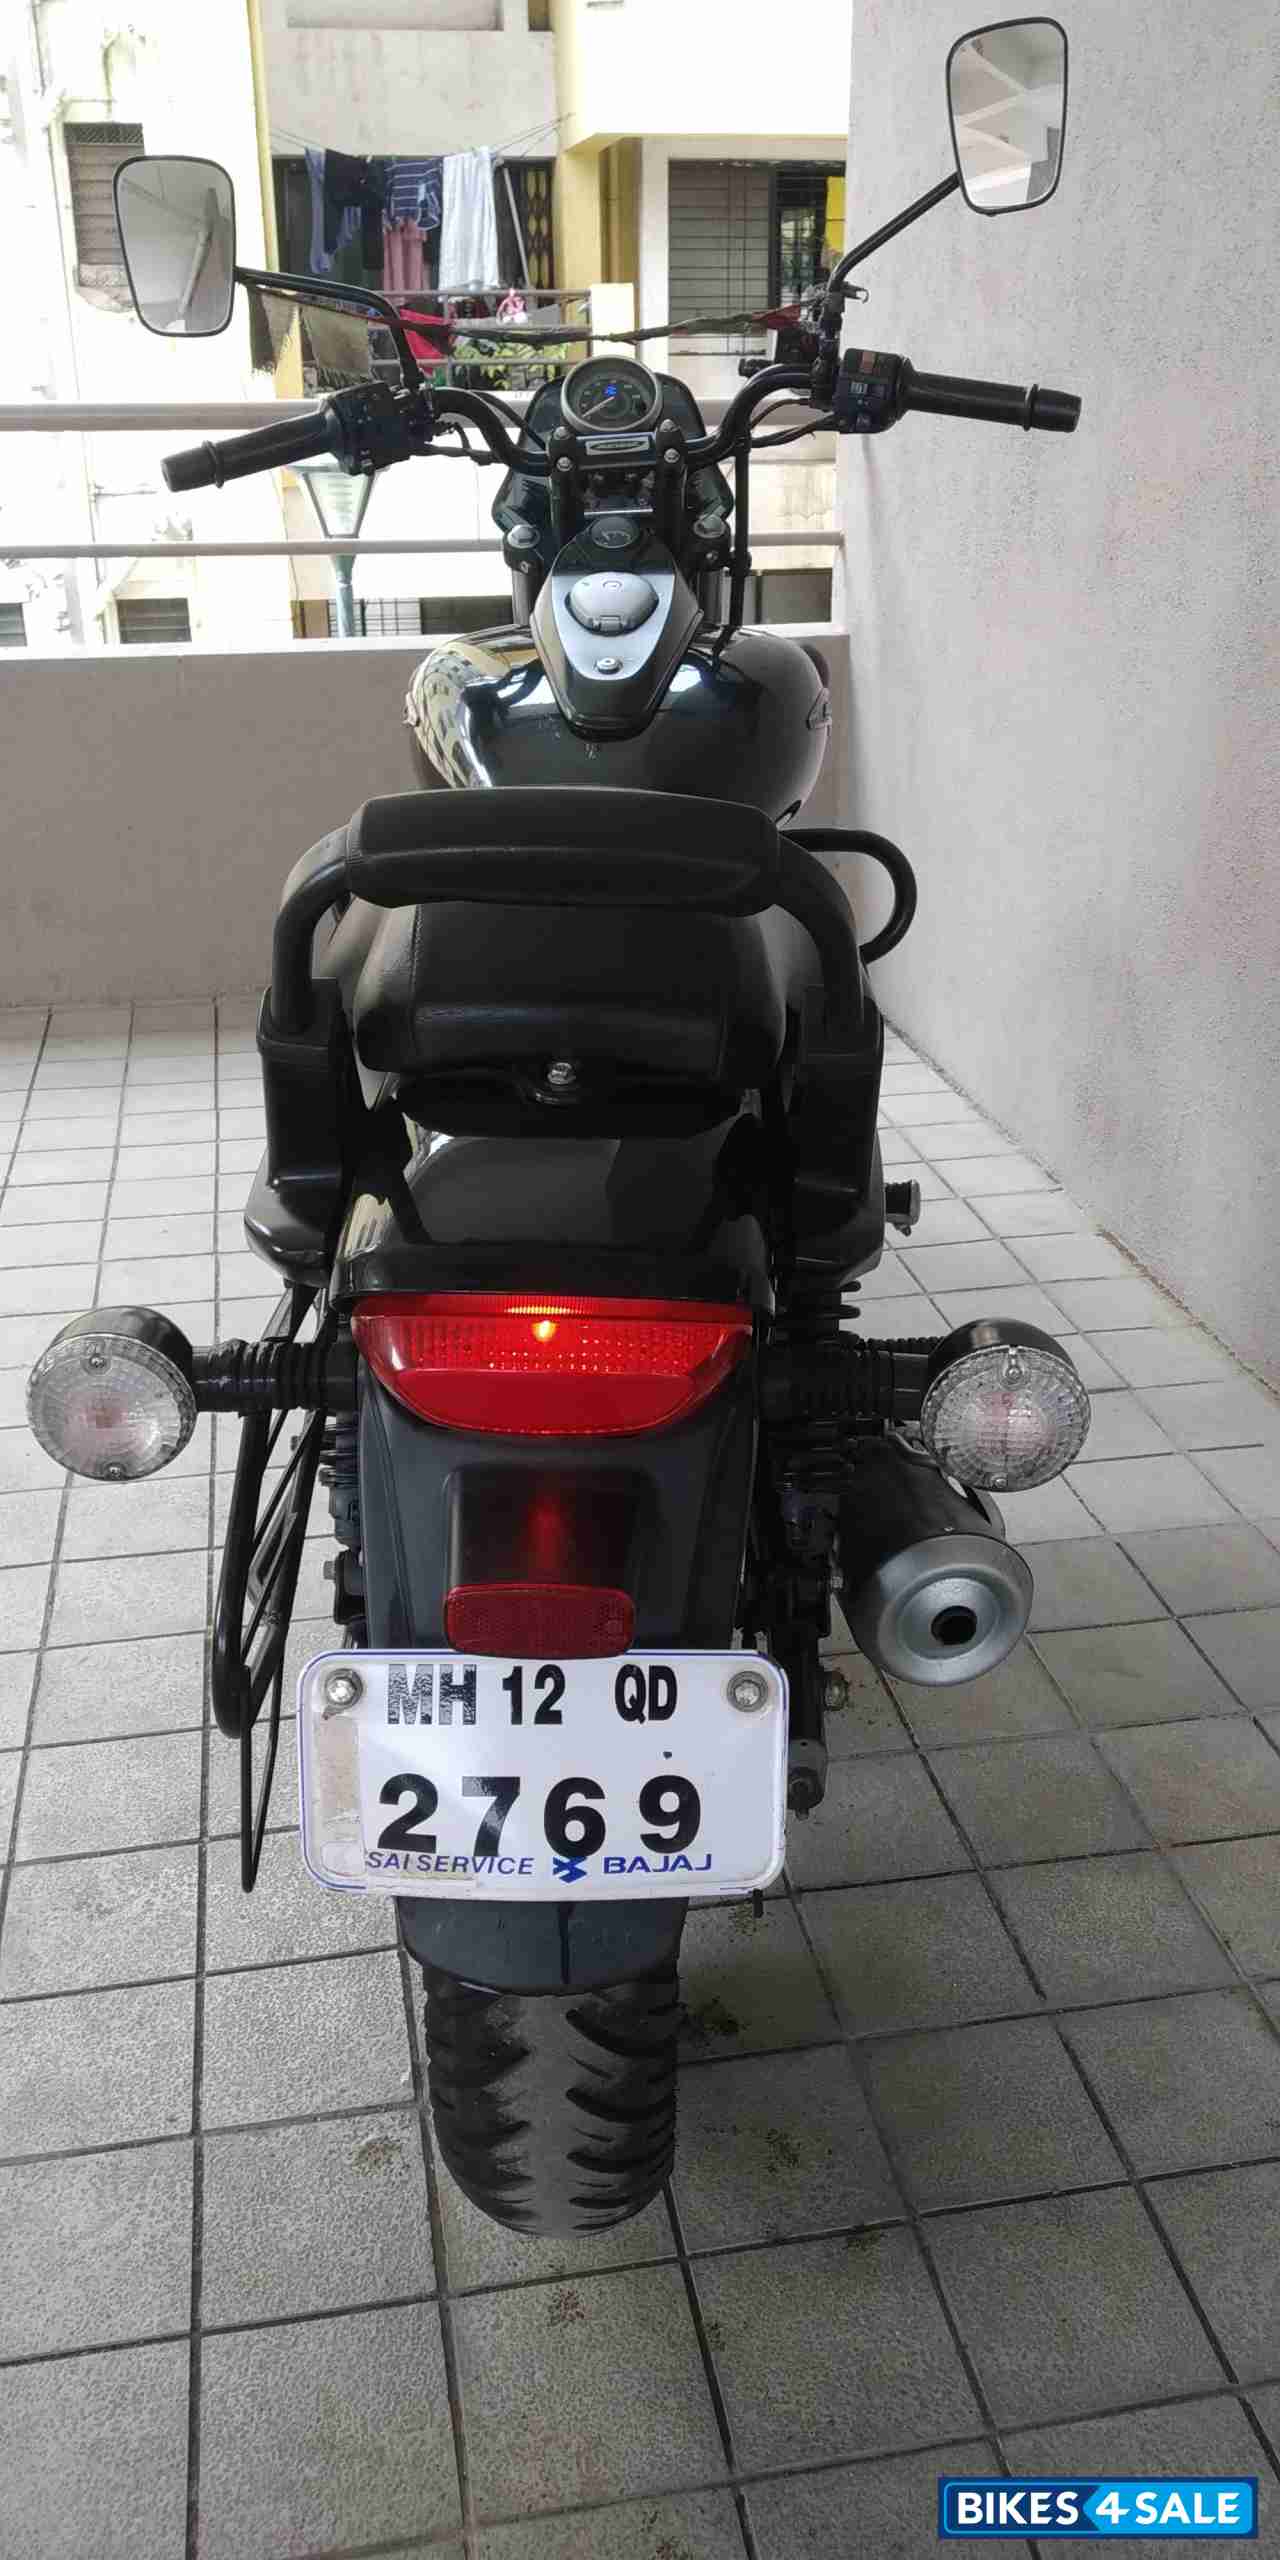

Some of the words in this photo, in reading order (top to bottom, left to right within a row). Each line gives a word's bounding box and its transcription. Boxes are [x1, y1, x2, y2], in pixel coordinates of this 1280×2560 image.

[387, 1663, 478, 1725] MH
[502, 1664, 567, 1725] 12
[614, 1664, 679, 1723] QD
[377, 1773, 701, 1858] 2769
[366, 1850, 410, 1870] SAI
[416, 1854, 535, 1875] SERVICE
[603, 1853, 713, 1874] BAJAJ
